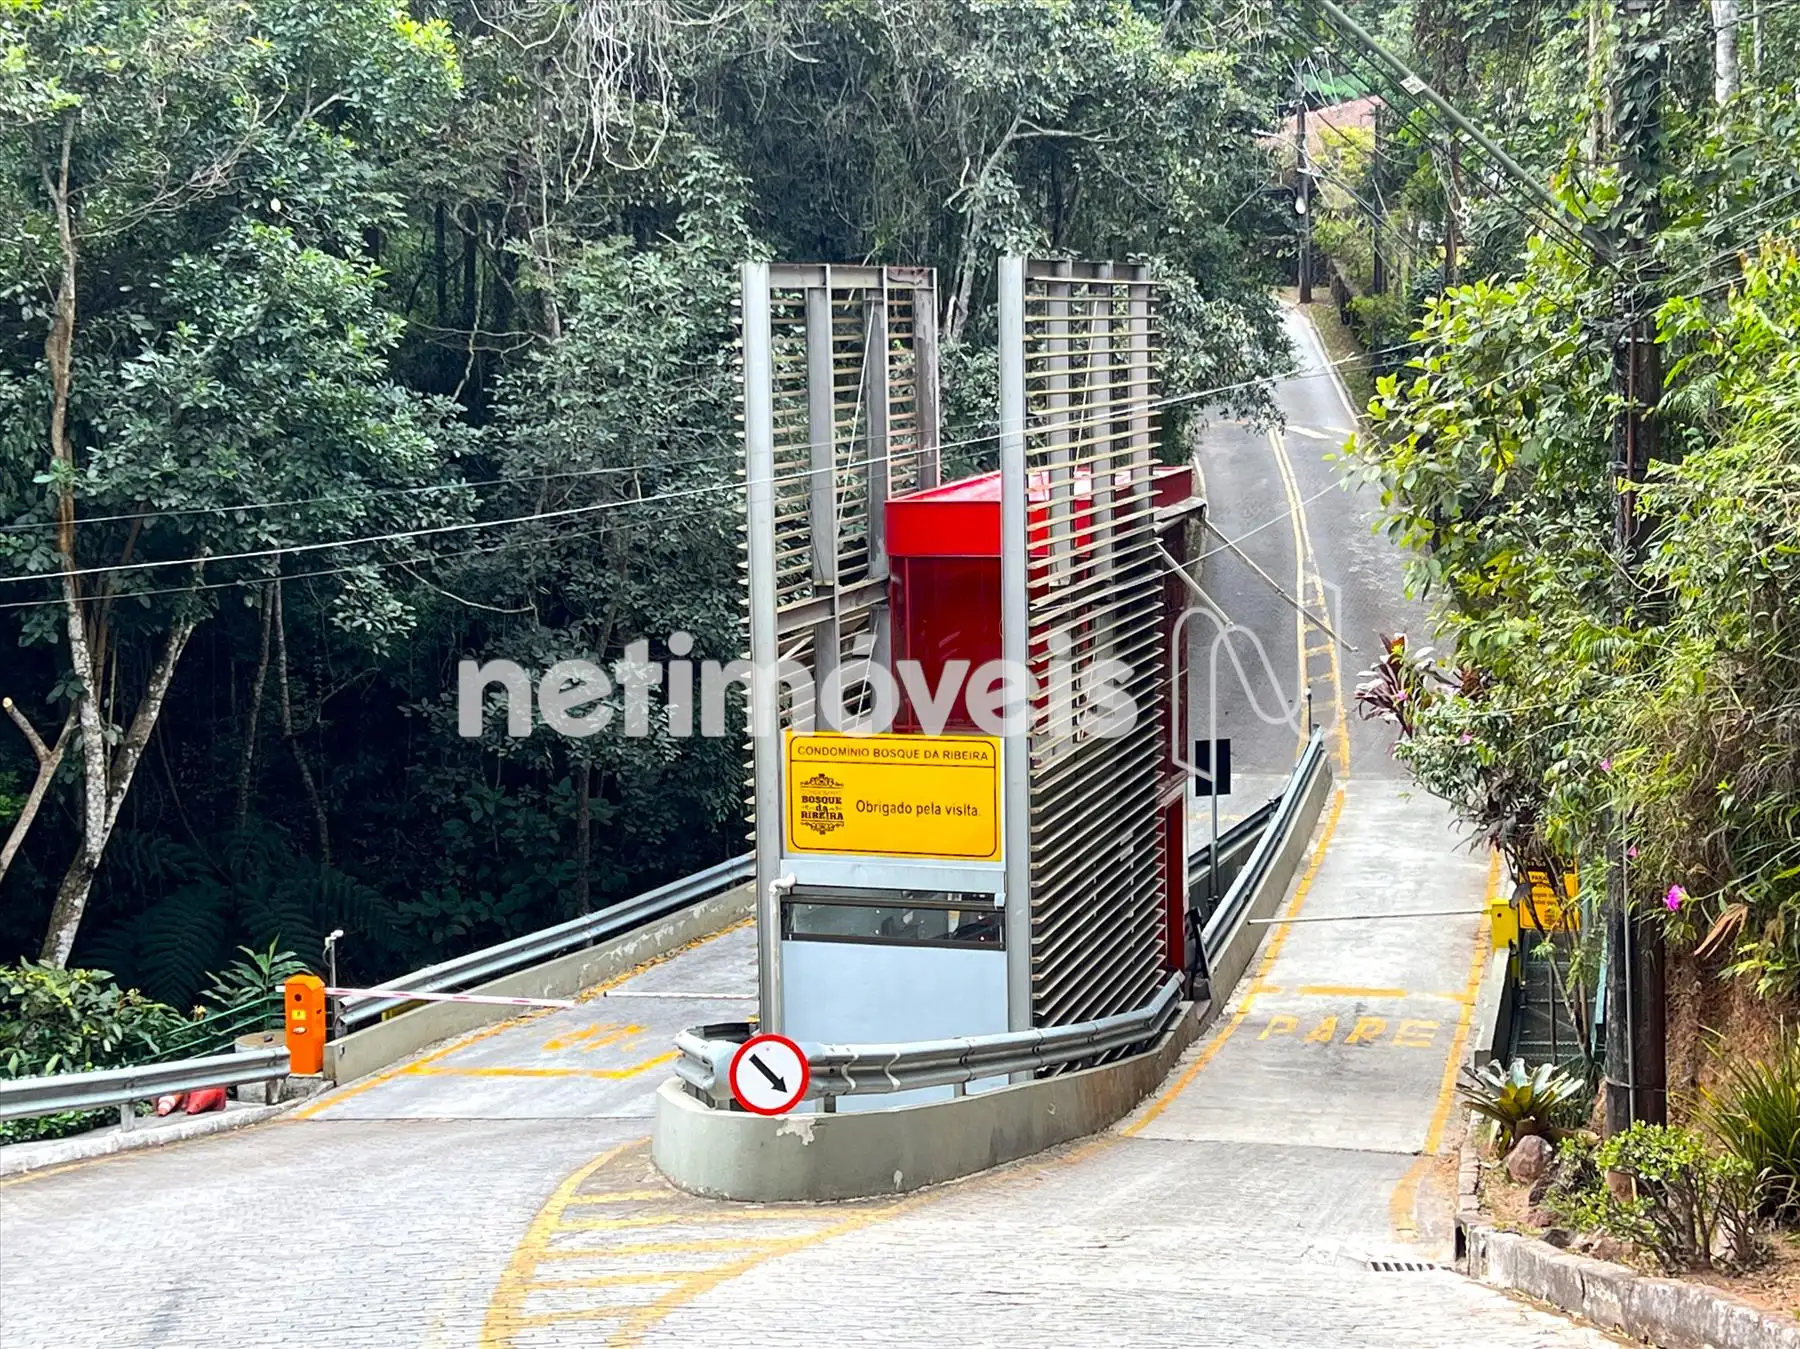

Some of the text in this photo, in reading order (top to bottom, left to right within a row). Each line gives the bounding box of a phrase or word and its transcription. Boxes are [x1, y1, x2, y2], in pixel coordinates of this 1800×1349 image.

[873, 748, 920, 759] BOSQUE
[924, 749, 940, 759] DA
[943, 750, 989, 761] RIBEIRA
[801, 795, 842, 805] BOSQUE
[855, 799, 913, 817] Obrigado
[916, 801, 942, 818] pela
[1256, 1014, 1440, 1047] PARE
